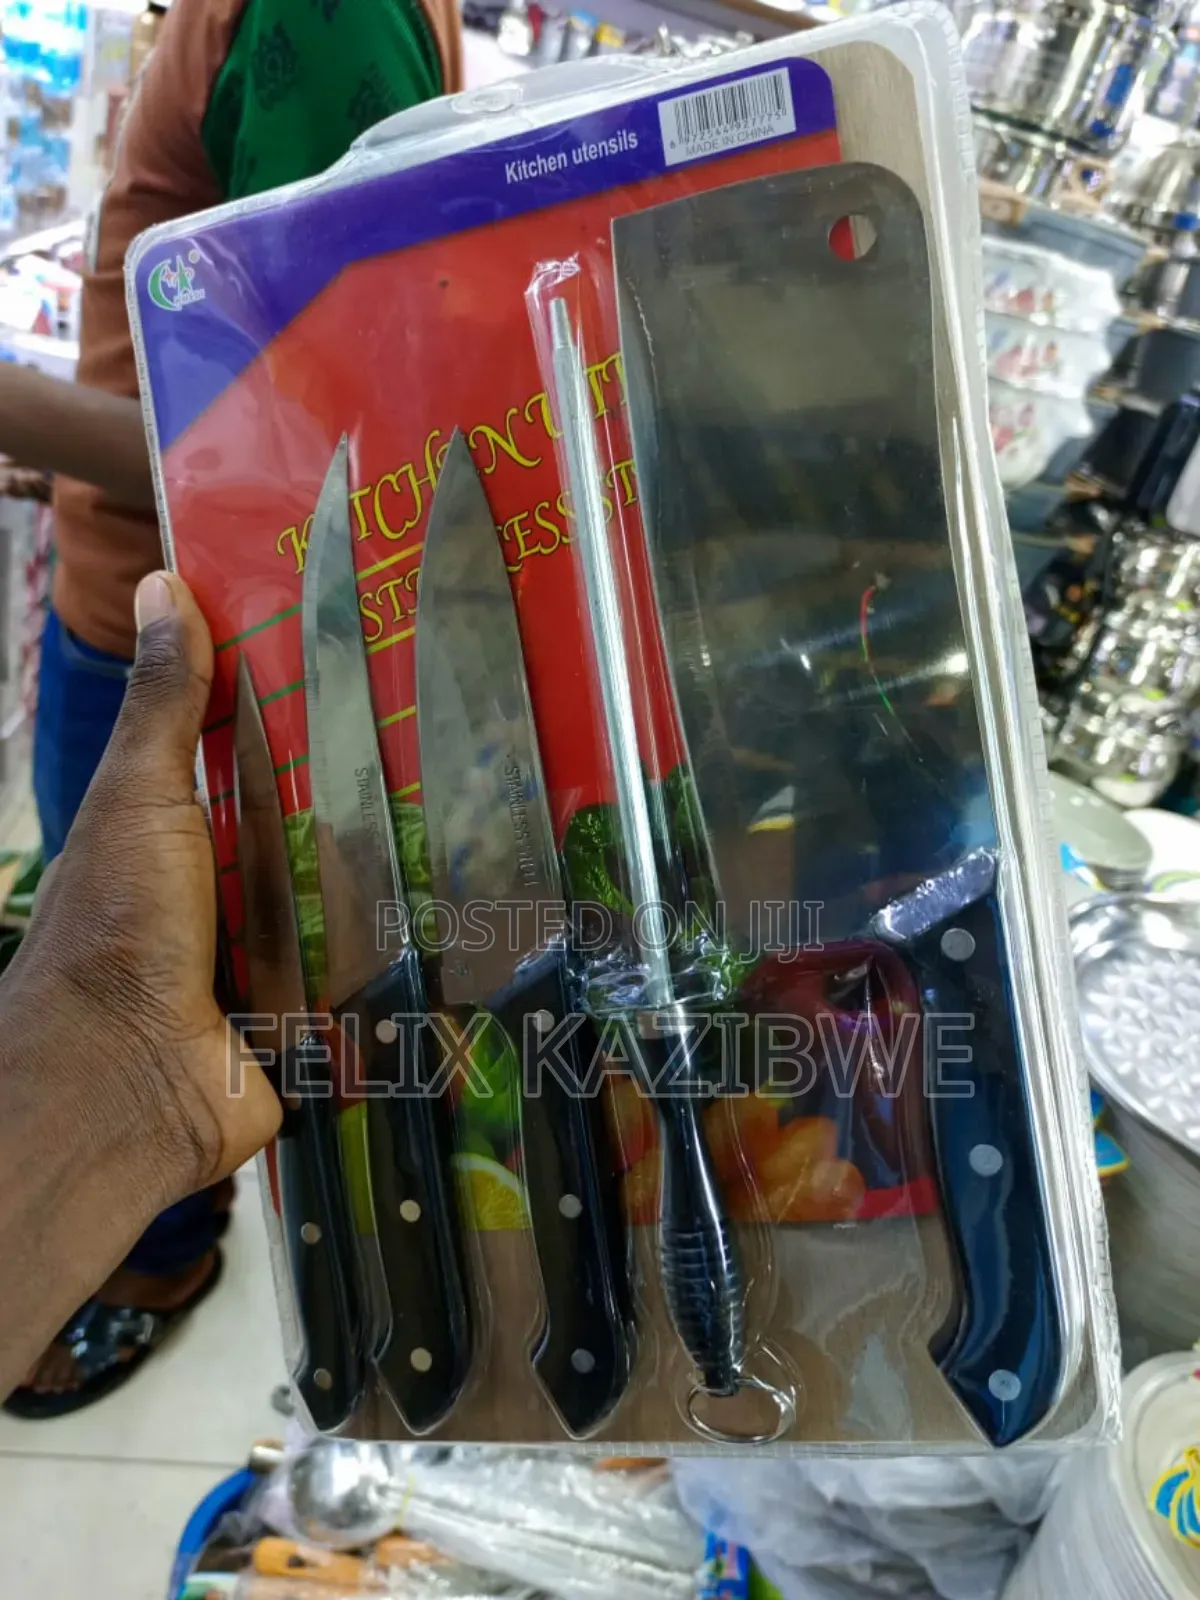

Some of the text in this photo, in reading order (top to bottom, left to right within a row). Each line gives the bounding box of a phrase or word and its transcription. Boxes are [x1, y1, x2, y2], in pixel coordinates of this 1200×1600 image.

[505, 128, 639, 184] Kitchen utensils
[685, 124, 775, 157] MADE IN CHINA
